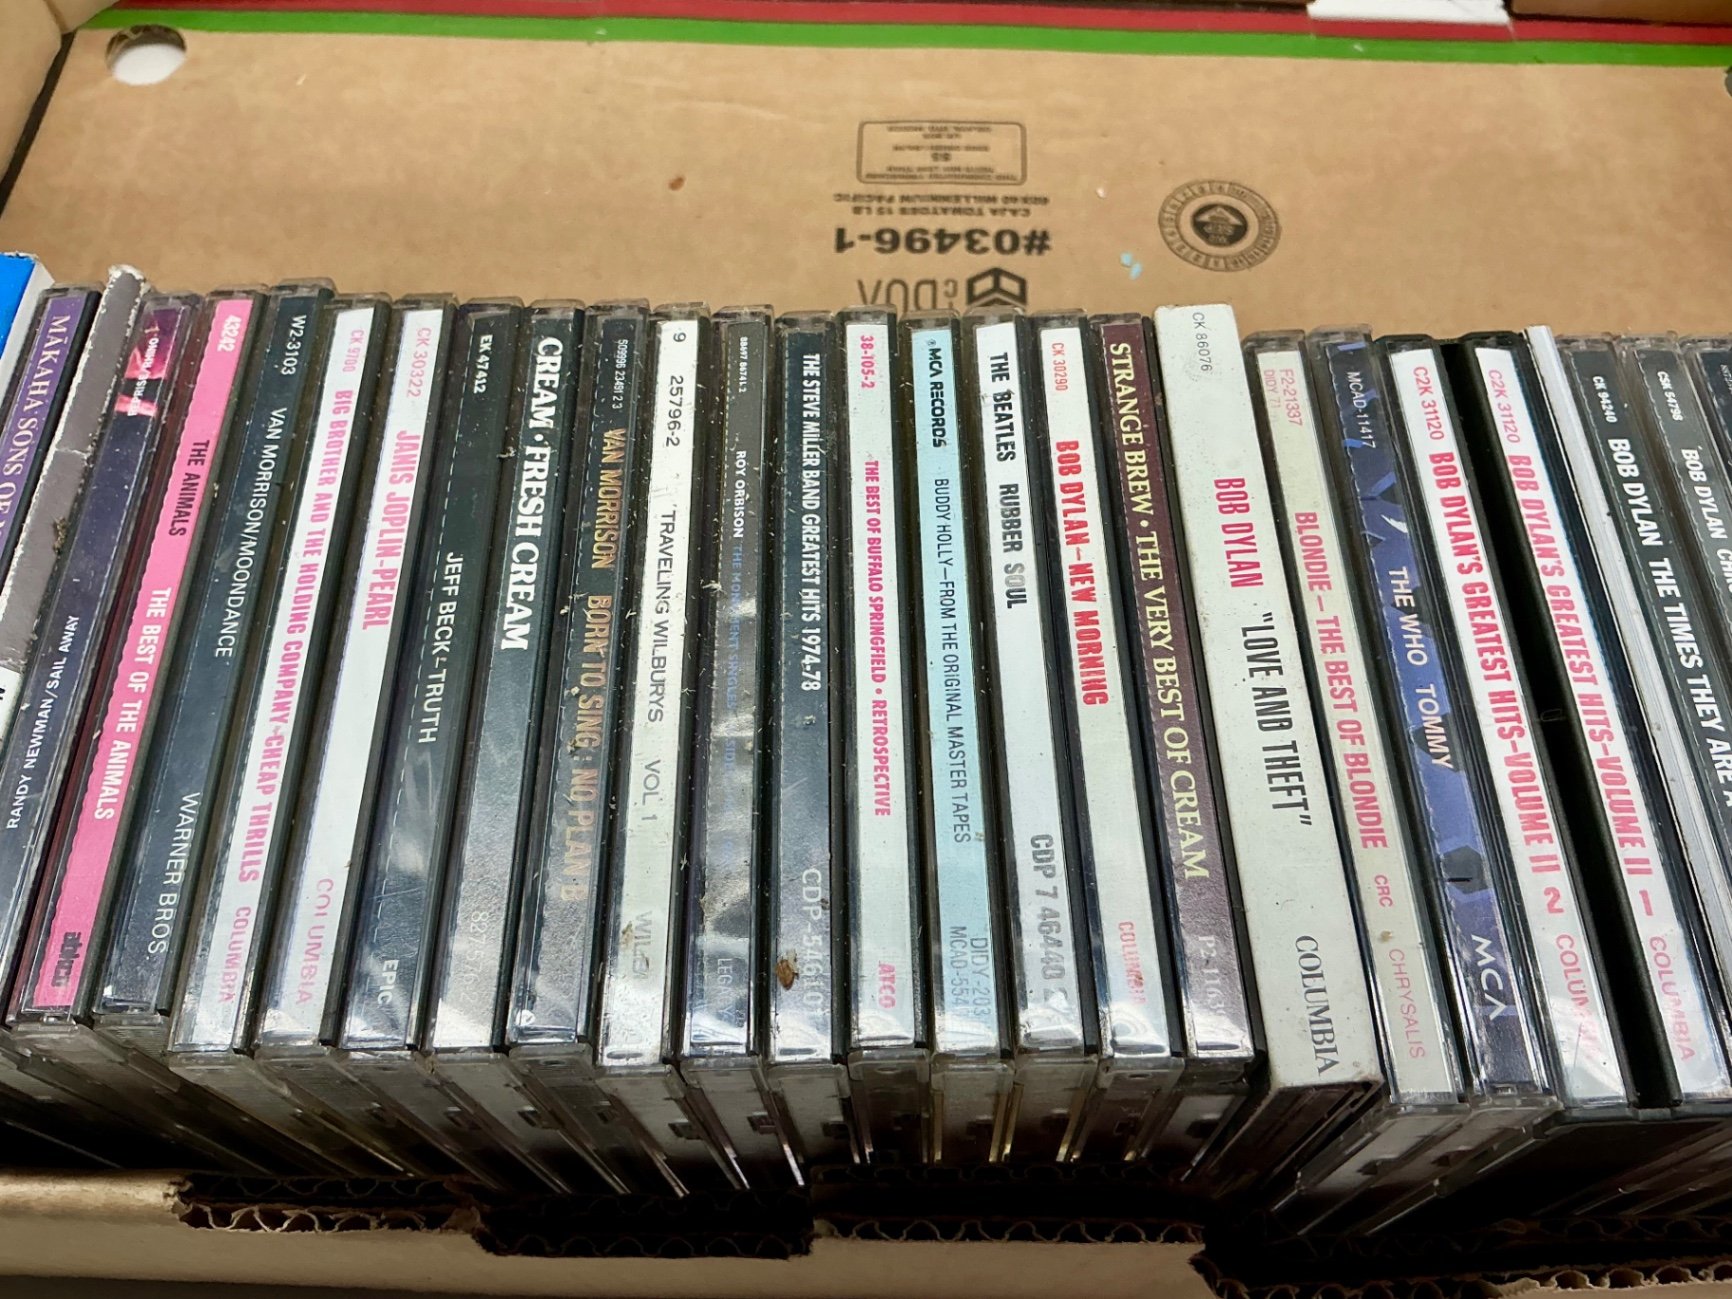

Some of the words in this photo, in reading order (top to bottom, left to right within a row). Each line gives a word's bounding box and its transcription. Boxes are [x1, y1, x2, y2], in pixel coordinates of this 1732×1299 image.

[833, 226, 1053, 256] #03496-1
[217, 314, 243, 353] 43242
[347, 329, 365, 348] CK
[417, 327, 432, 349] CK
[478, 334, 494, 352] EK
[673, 332, 687, 343] 9
[1191, 312, 1206, 331] CK
[281, 314, 308, 376] W2-3103
[341, 348, 363, 374] 9700
[802, 353, 821, 377] THE
[860, 335, 876, 389] 38-105-2
[928, 348, 943, 378] MCA
[989, 352, 1011, 383] THE
[1050, 342, 1066, 357] CK
[1195, 333, 1214, 373] 86076
[405, 355, 428, 398] 30322
[472, 354, 490, 394] 47412
[527, 337, 564, 429] CREAM
[1052, 358, 1069, 393] 30290
[1109, 343, 1144, 447] STRANGE
[1263, 369, 1279, 395] DIDY
[1412, 366, 1435, 397] C2K
[1488, 369, 1509, 399] C2K
[1592, 375, 1608, 391] CK
[1656, 370, 1674, 391] CSK
[332, 389, 354, 416] BIG
[666, 374, 685, 448] 25796-2
[802, 379, 822, 418] STEVE
[930, 381, 947, 449] RECORDS
[1280, 369, 1304, 427] F2-21337
[1346, 371, 1377, 449] MCAD-11417
[1420, 399, 1446, 441] 31120
[263, 407, 288, 441] VAN
[802, 421, 822, 467] MILLER
[991, 391, 1018, 463] BEATLES
[1497, 399, 1522, 444] 31120
[3, 417, 38, 476] SONS
[188, 438, 210, 466] THE
[316, 420, 348, 488] BROTHER
[388, 430, 421, 486] JANIS
[602, 428, 627, 464] VAN
[735, 450, 748, 477] ROY
[1055, 440, 1082, 477] BOB
[1607, 438, 1640, 479] BOB
[1681, 448, 1708, 482] BOB
[514, 444, 551, 538] FRESH
[802, 469, 822, 510] BAND
[864, 460, 880, 482] THE
[1124, 451, 1154, 517] BREW
[1428, 451, 1462, 489] BOB
[1507, 454, 1541, 491] BOB
[168, 471, 203, 537] ANIMALS
[310, 492, 333, 524] AND
[591, 468, 625, 570] MORRISON
[732, 479, 747, 539] ORBISON
[866, 485, 881, 515] BEST
[934, 478, 951, 521] BUDDY
[1213, 477, 1251, 515] BOB
[1622, 482, 1665, 546] DYLAN
[1693, 485, 1729, 539] DYLAN
[866, 515, 882, 532] OF
[999, 484, 1023, 555] RUBBER
[1439, 493, 1483, 577] DYLAN'S
[1520, 498, 1566, 578] DYLAN'S
[214, 443, 277, 659] MORRISON/MOONDANCE
[304, 528, 327, 559] THE
[653, 509, 678, 615] TRAVELING
[732, 544, 744, 569] THE
[801, 513, 821, 586] GREATEST
[866, 533, 885, 589] BUFFALO
[1134, 530, 1163, 582] THE
[1220, 517, 1264, 589] DYLAN
[1294, 511, 1333, 592] BLONDIE
[441, 551, 464, 597] JEFF
[500, 541, 540, 651] CREAM
[1004, 563, 1029, 610] SOUL
[1388, 566, 1416, 608] THE
[1649, 557, 1681, 598] THE
[145, 587, 171, 618] THE
[286, 561, 320, 635] HOLDING
[801, 588, 821, 623] HITS
[1141, 587, 1175, 654] VERY
[134, 624, 162, 665] BEST
[582, 595, 613, 655] BORN
[867, 593, 887, 684] SPRINGFIELD
[940, 622, 959, 649] THE
[1315, 615, 1346, 655] THE
[1399, 613, 1429, 666] WHO
[1461, 581, 1513, 682] GREATEST
[1545, 584, 1599, 686] GREATEST
[1663, 602, 1704, 669] TIMES
[580, 661, 607, 688] TO
[647, 619, 670, 723] WILBURYS
[801, 627, 822, 692] 1974-78
[1071, 610, 1109, 706] MORNING
[128, 671, 149, 694] OF
[942, 653, 962, 722] ORIGINAL
[1150, 656, 1185, 722] BEST
[1324, 660, 1359, 713] BEST
[1686, 674, 1726, 732] THEY
[6, 774, 32, 829] RANDY
[23, 657, 68, 770] NEWMAN/SAIL
[58, 615, 80, 653] AWAY
[116, 699, 142, 733] THE
[574, 694, 605, 749] SING
[1251, 686, 1295, 732] AND
[1414, 683, 1455, 772] TOMMY
[1163, 726, 1194, 765] OF
[1337, 719, 1368, 747] OF
[94, 739, 132, 820] ANIMALS
[871, 700, 892, 817] RETROSPECTIVE
[946, 726, 968, 789] MASTER
[1706, 738, 1732, 785] ARE
[569, 767, 599, 801] NO
[641, 759, 662, 806] VOL
[1343, 751, 1389, 850] BLONDIE
[163, 792, 200, 887] WARNER
[952, 791, 972, 843] TAPES
[1170, 770, 1210, 880] CREAM
[237, 801, 272, 884] THRILLS
[563, 810, 595, 877] PLAN
[1030, 834, 1057, 879] CDP
[1529, 854, 1562, 874] II
[1623, 858, 1654, 876] II
[560, 884, 589, 902] B
[1035, 885, 1059, 899] 7
[1373, 874, 1394, 908] CRC
[1543, 886, 1565, 915] 2
[1639, 889, 1654, 917] 1
[147, 893, 178, 955] BROS
[1037, 906, 1066, 981] 46440
[218, 905, 252, 1005] COLUMBIA
[1471, 933, 1511, 1022] MCA
[377, 958, 399, 1004] EPIC
[878, 961, 897, 1010] ATCO
[1388, 947, 1427, 1060] CHRYSALIS
[1649, 936, 1696, 1062] COLUMBIA
[1294, 934, 1339, 1076] COLUMBIA
